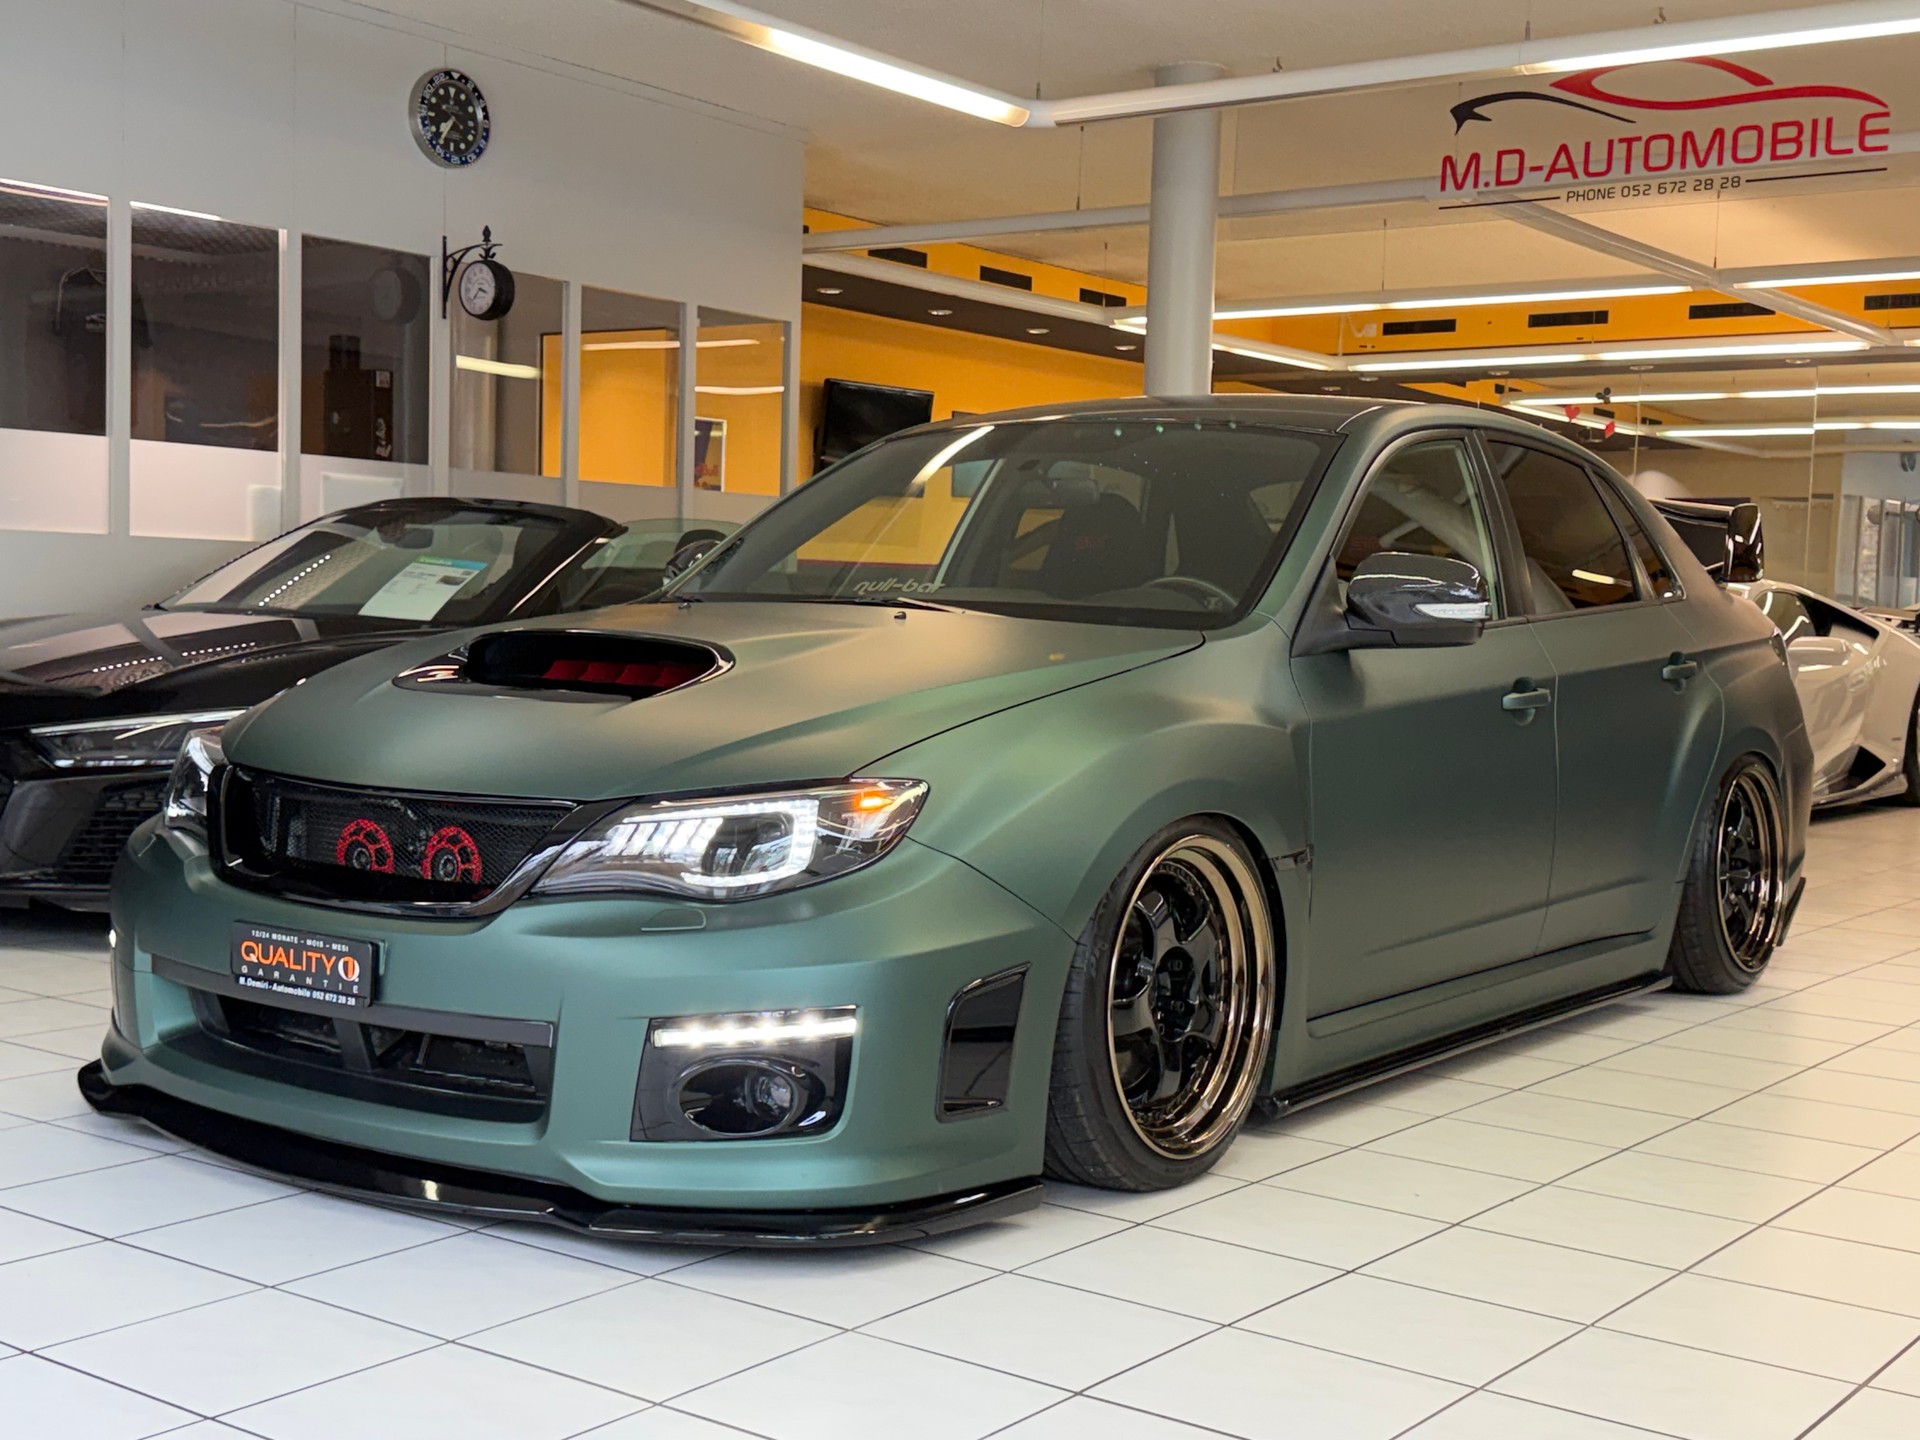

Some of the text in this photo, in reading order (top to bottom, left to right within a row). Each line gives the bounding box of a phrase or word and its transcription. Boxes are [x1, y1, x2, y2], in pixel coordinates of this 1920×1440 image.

[1440, 111, 1890, 192] M.D-AUTOMOBILE
[1566, 175, 1741, 202] PHONE 052 672 28 28
[241, 940, 336, 975] QUALITY
[241, 965, 359, 994] GARANTIE
